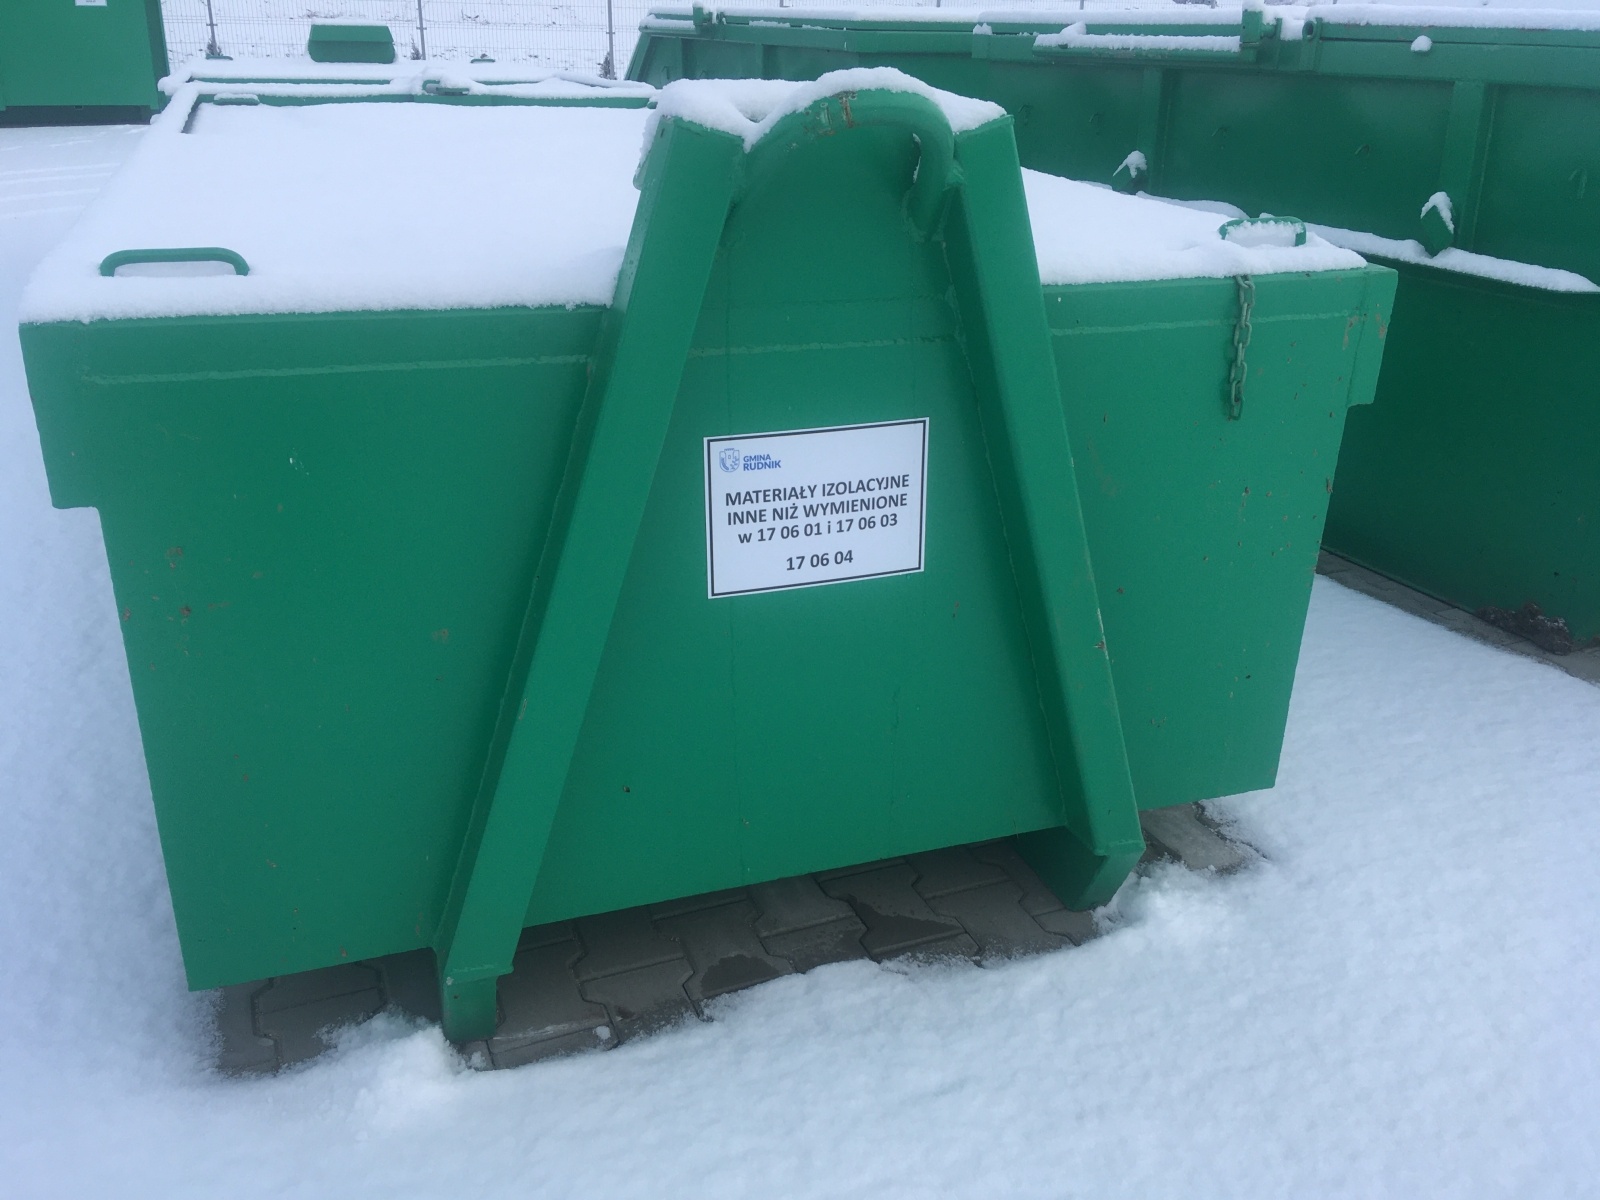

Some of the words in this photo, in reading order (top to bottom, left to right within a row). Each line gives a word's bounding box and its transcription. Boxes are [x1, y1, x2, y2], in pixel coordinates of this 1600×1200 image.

[743, 454, 771, 463] GMINA
[743, 460, 782, 471] RUDNIK
[725, 484, 818, 507] MATERIAŁY
[822, 474, 910, 497] IZOLACYJNE
[727, 509, 767, 526] INNE
[772, 503, 799, 522] NIŻ
[803, 493, 908, 518] WYMIENIONE
[738, 532, 753, 544] w
[757, 527, 776, 542] 17
[780, 525, 800, 540] 06
[803, 522, 823, 537] 01
[827, 520, 831, 535] i
[836, 518, 854, 533] 17
[858, 516, 877, 531] 06
[880, 513, 898, 528] 03
[786, 555, 806, 571] 17
[810, 552, 830, 568] 06
[834, 549, 854, 565] 04
